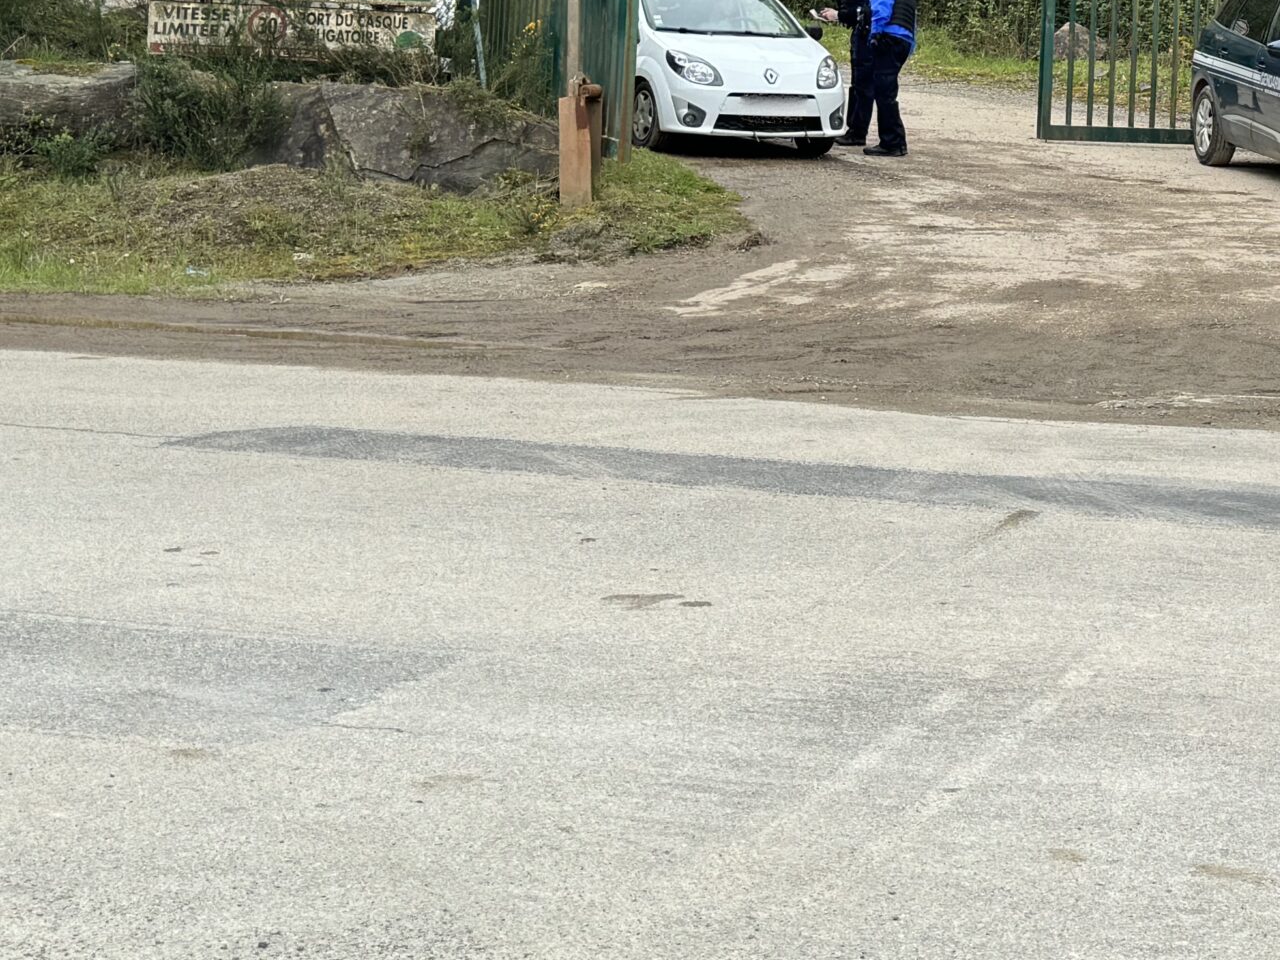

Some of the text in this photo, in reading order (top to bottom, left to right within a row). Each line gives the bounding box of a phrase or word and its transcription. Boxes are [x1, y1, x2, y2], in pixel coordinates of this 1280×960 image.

[163, 5, 231, 22] VITESSE
[335, 13, 354, 27] DU
[357, 15, 409, 30] CASQUE
[153, 21, 222, 38] LIMITEE
[256, 15, 278, 36] 30
